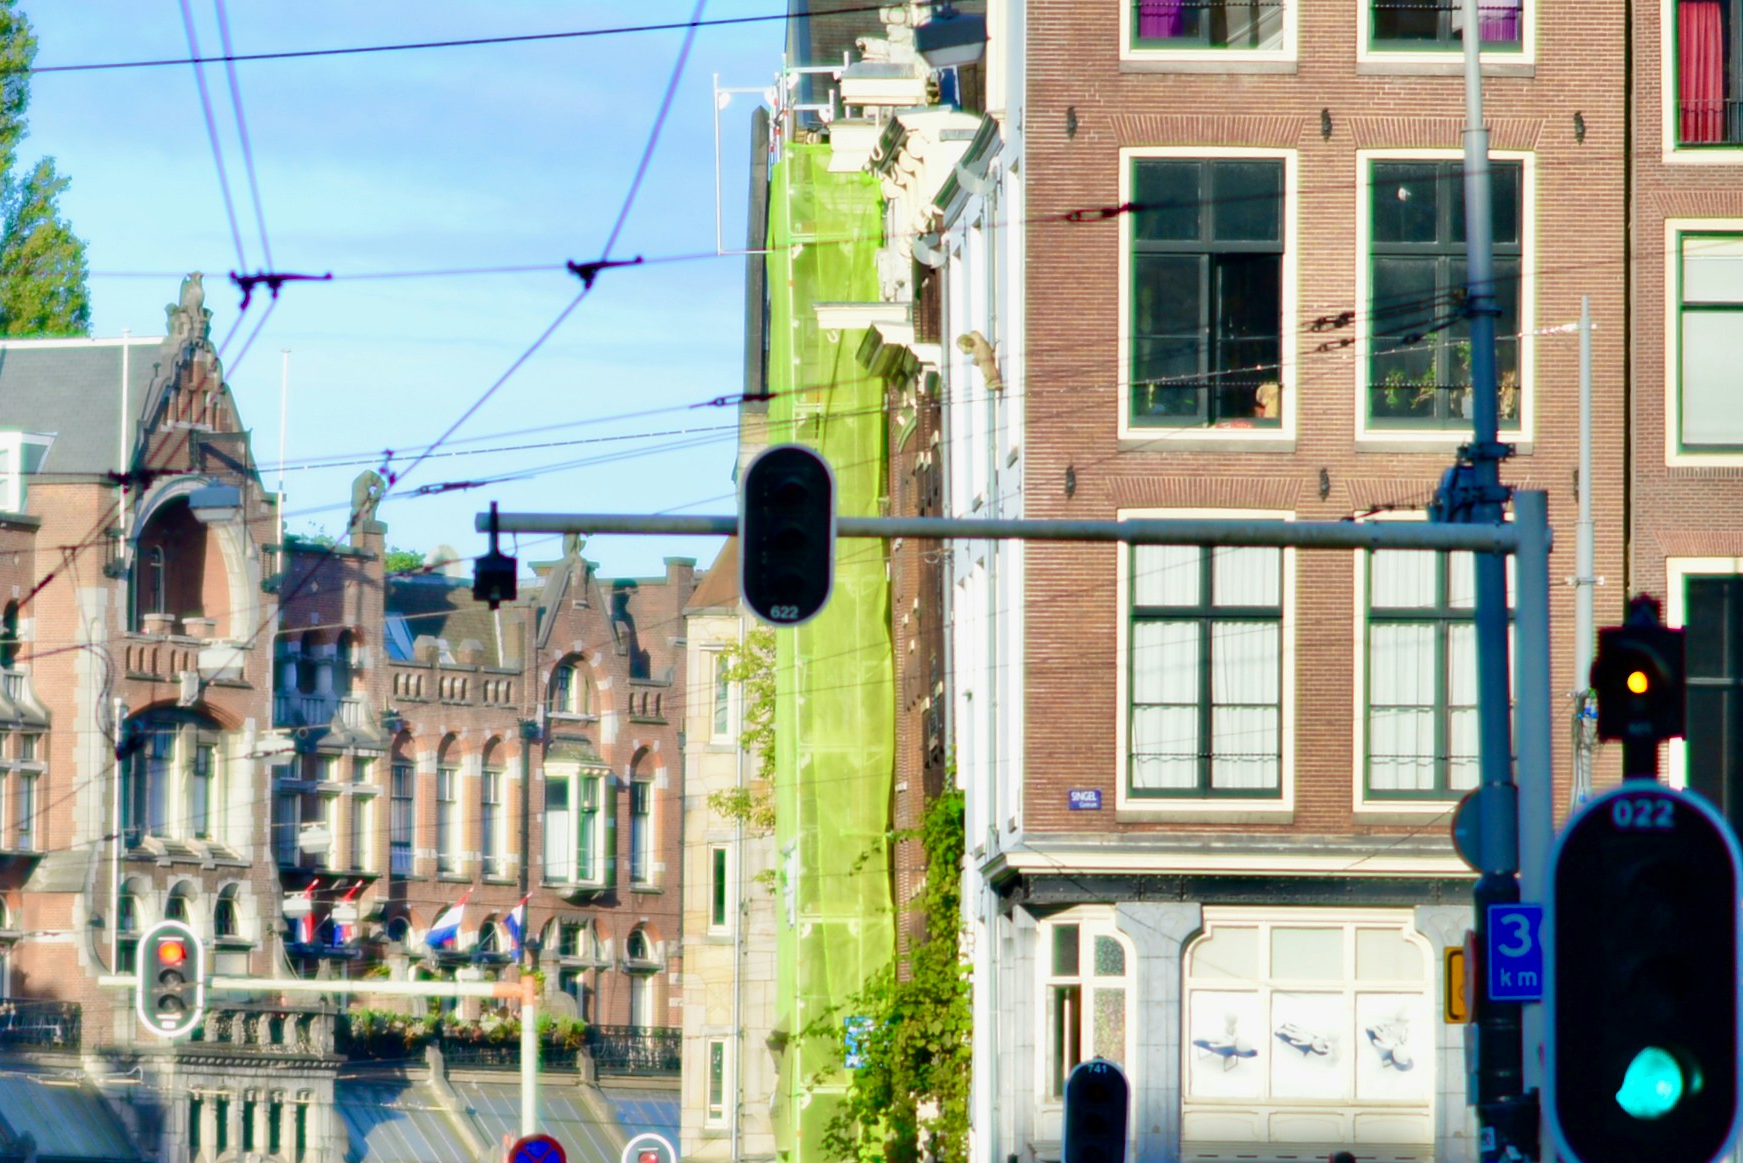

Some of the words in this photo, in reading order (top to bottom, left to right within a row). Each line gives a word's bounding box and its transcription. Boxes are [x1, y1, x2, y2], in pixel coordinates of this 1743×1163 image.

[770, 605, 799, 619] 622
[1071, 791, 1096, 801] SINGEL
[1612, 798, 1675, 828] 022
[1498, 913, 1533, 958] 3
[1499, 967, 1538, 987] km
[1087, 1064, 1107, 1073] 741
